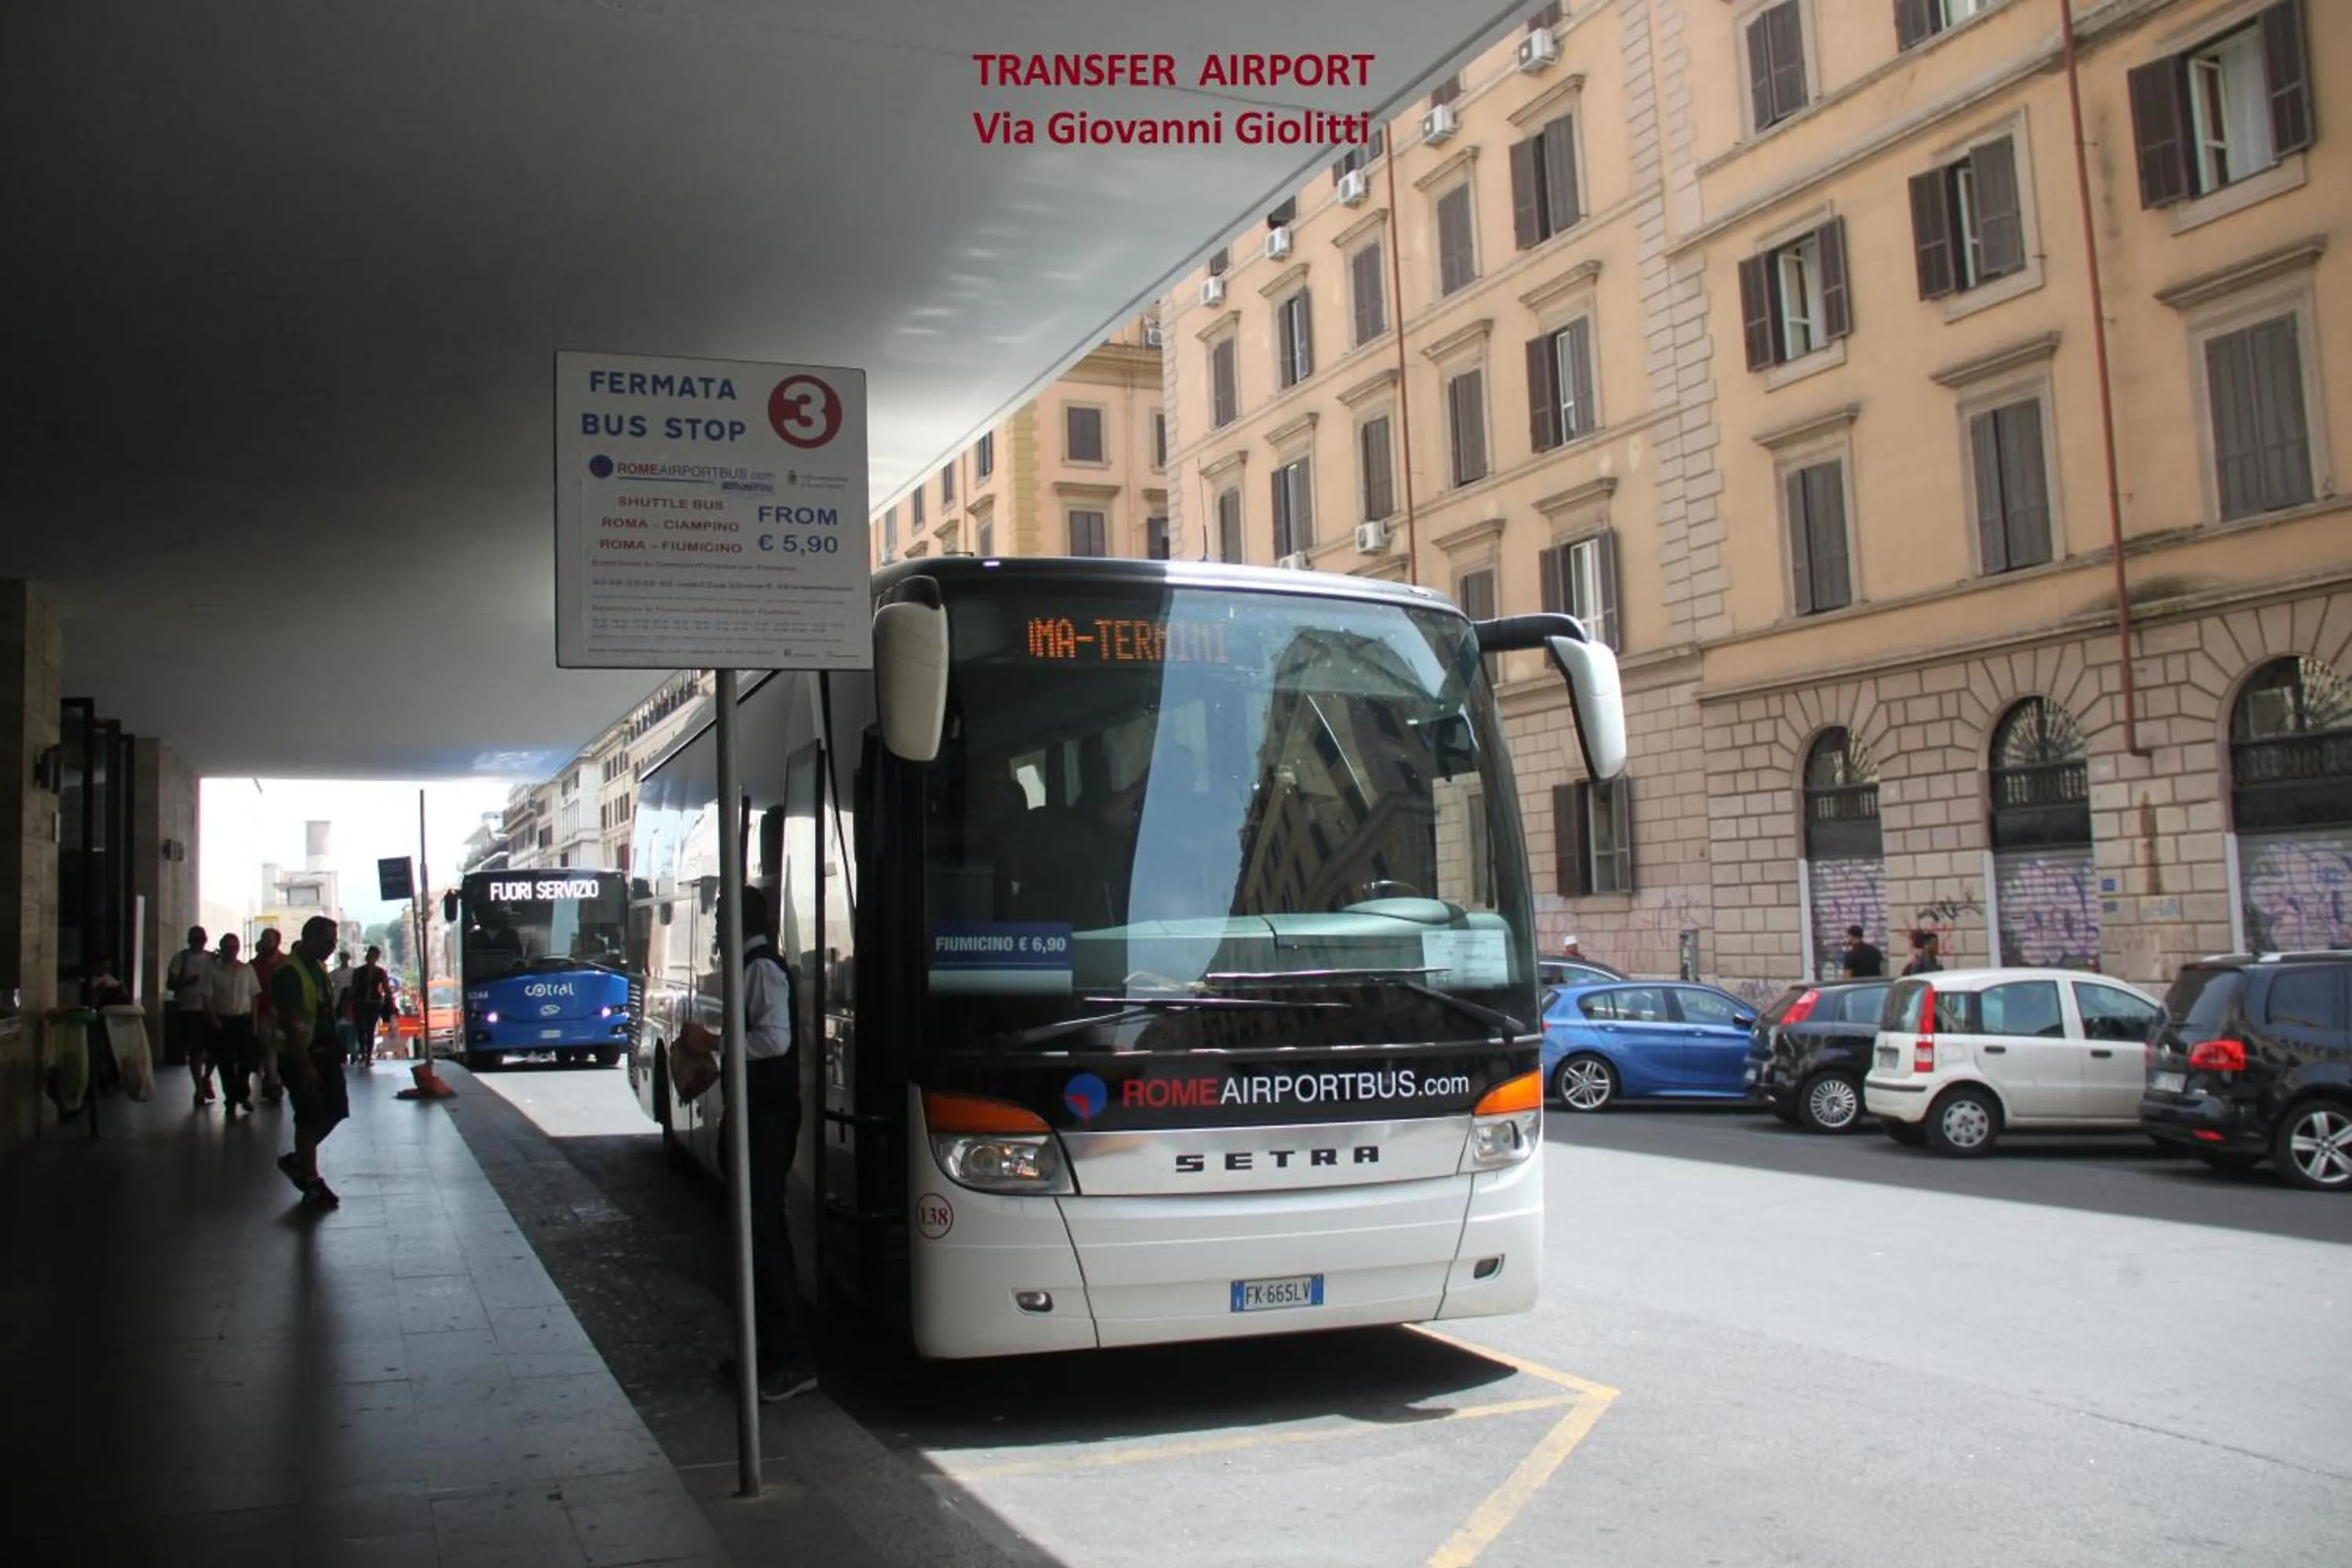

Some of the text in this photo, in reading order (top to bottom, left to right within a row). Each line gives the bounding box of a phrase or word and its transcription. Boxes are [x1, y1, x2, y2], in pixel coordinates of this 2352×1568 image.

[590, 371, 737, 400] FERMATA
[782, 380, 827, 442] 3
[582, 413, 746, 441] BUS STOP
[618, 495, 725, 511] SHUTTLE BUS
[602, 517, 649, 529] ROMA
[664, 519, 740, 533] CIAMPINO
[758, 506, 839, 526] FROM
[600, 539, 646, 550] ROMA
[662, 541, 743, 554] FIUMICINO
[758, 534, 839, 557] € 5,90
[490, 880, 599, 901] FUORI SERVIZIO
[935, 936, 1066, 954] FIUMICINO € 6,90
[1121, 1071, 1470, 1108] ROMEAIRPORTBUS.com
[1175, 1145, 1380, 1173] SETRA
[920, 1207, 948, 1226] 138
